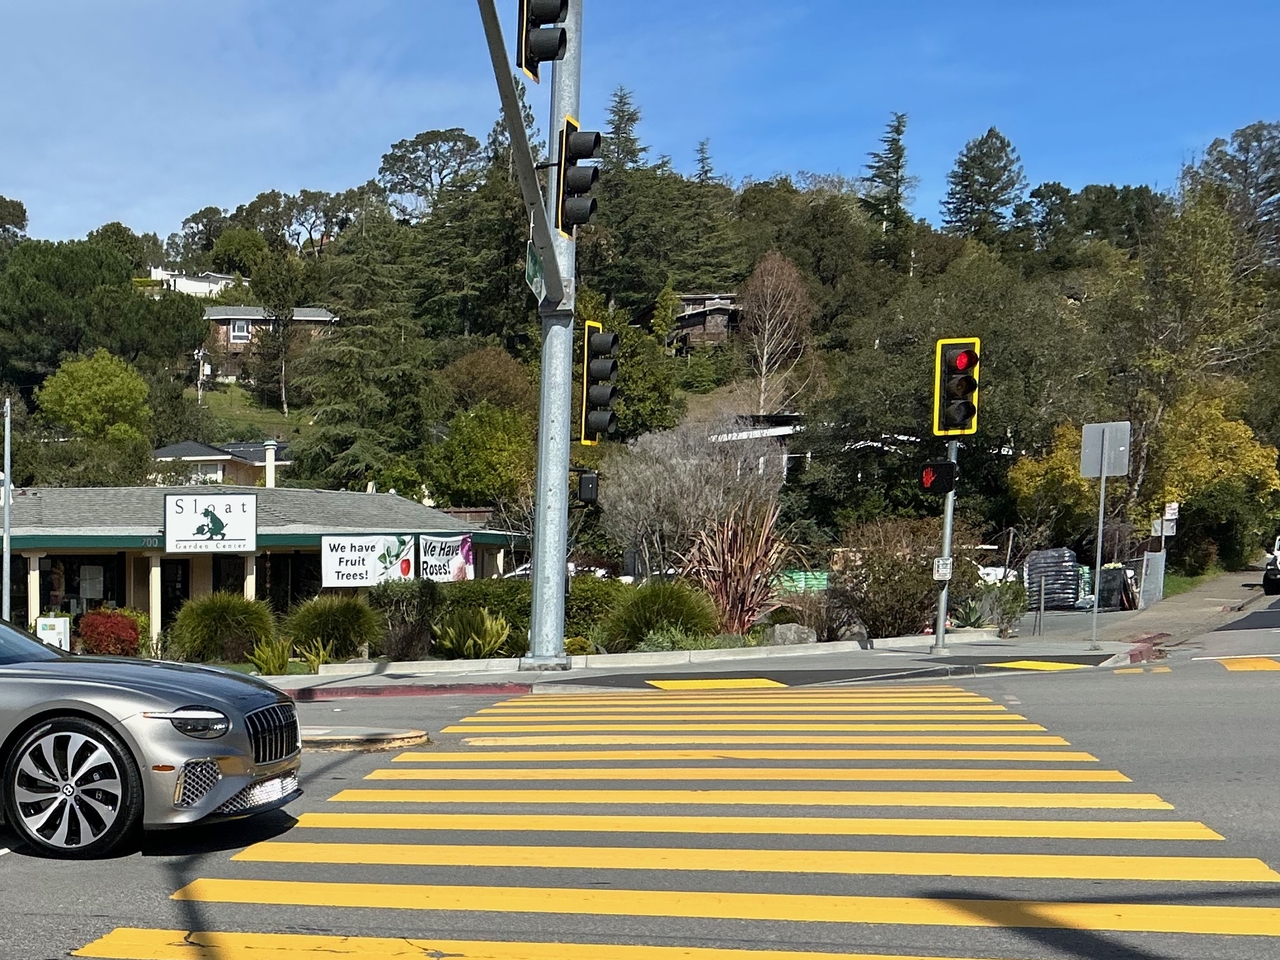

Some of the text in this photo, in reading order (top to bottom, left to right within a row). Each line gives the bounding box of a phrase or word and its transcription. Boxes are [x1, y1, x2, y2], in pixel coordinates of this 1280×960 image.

[175, 499, 247, 514] Sloat
[141, 538, 159, 548] 700
[329, 542, 376, 552] We have
[423, 542, 459, 557] We Have
[338, 557, 366, 567] Fruit
[422, 561, 451, 576] Roses!
[335, 570, 368, 580] Trees!
